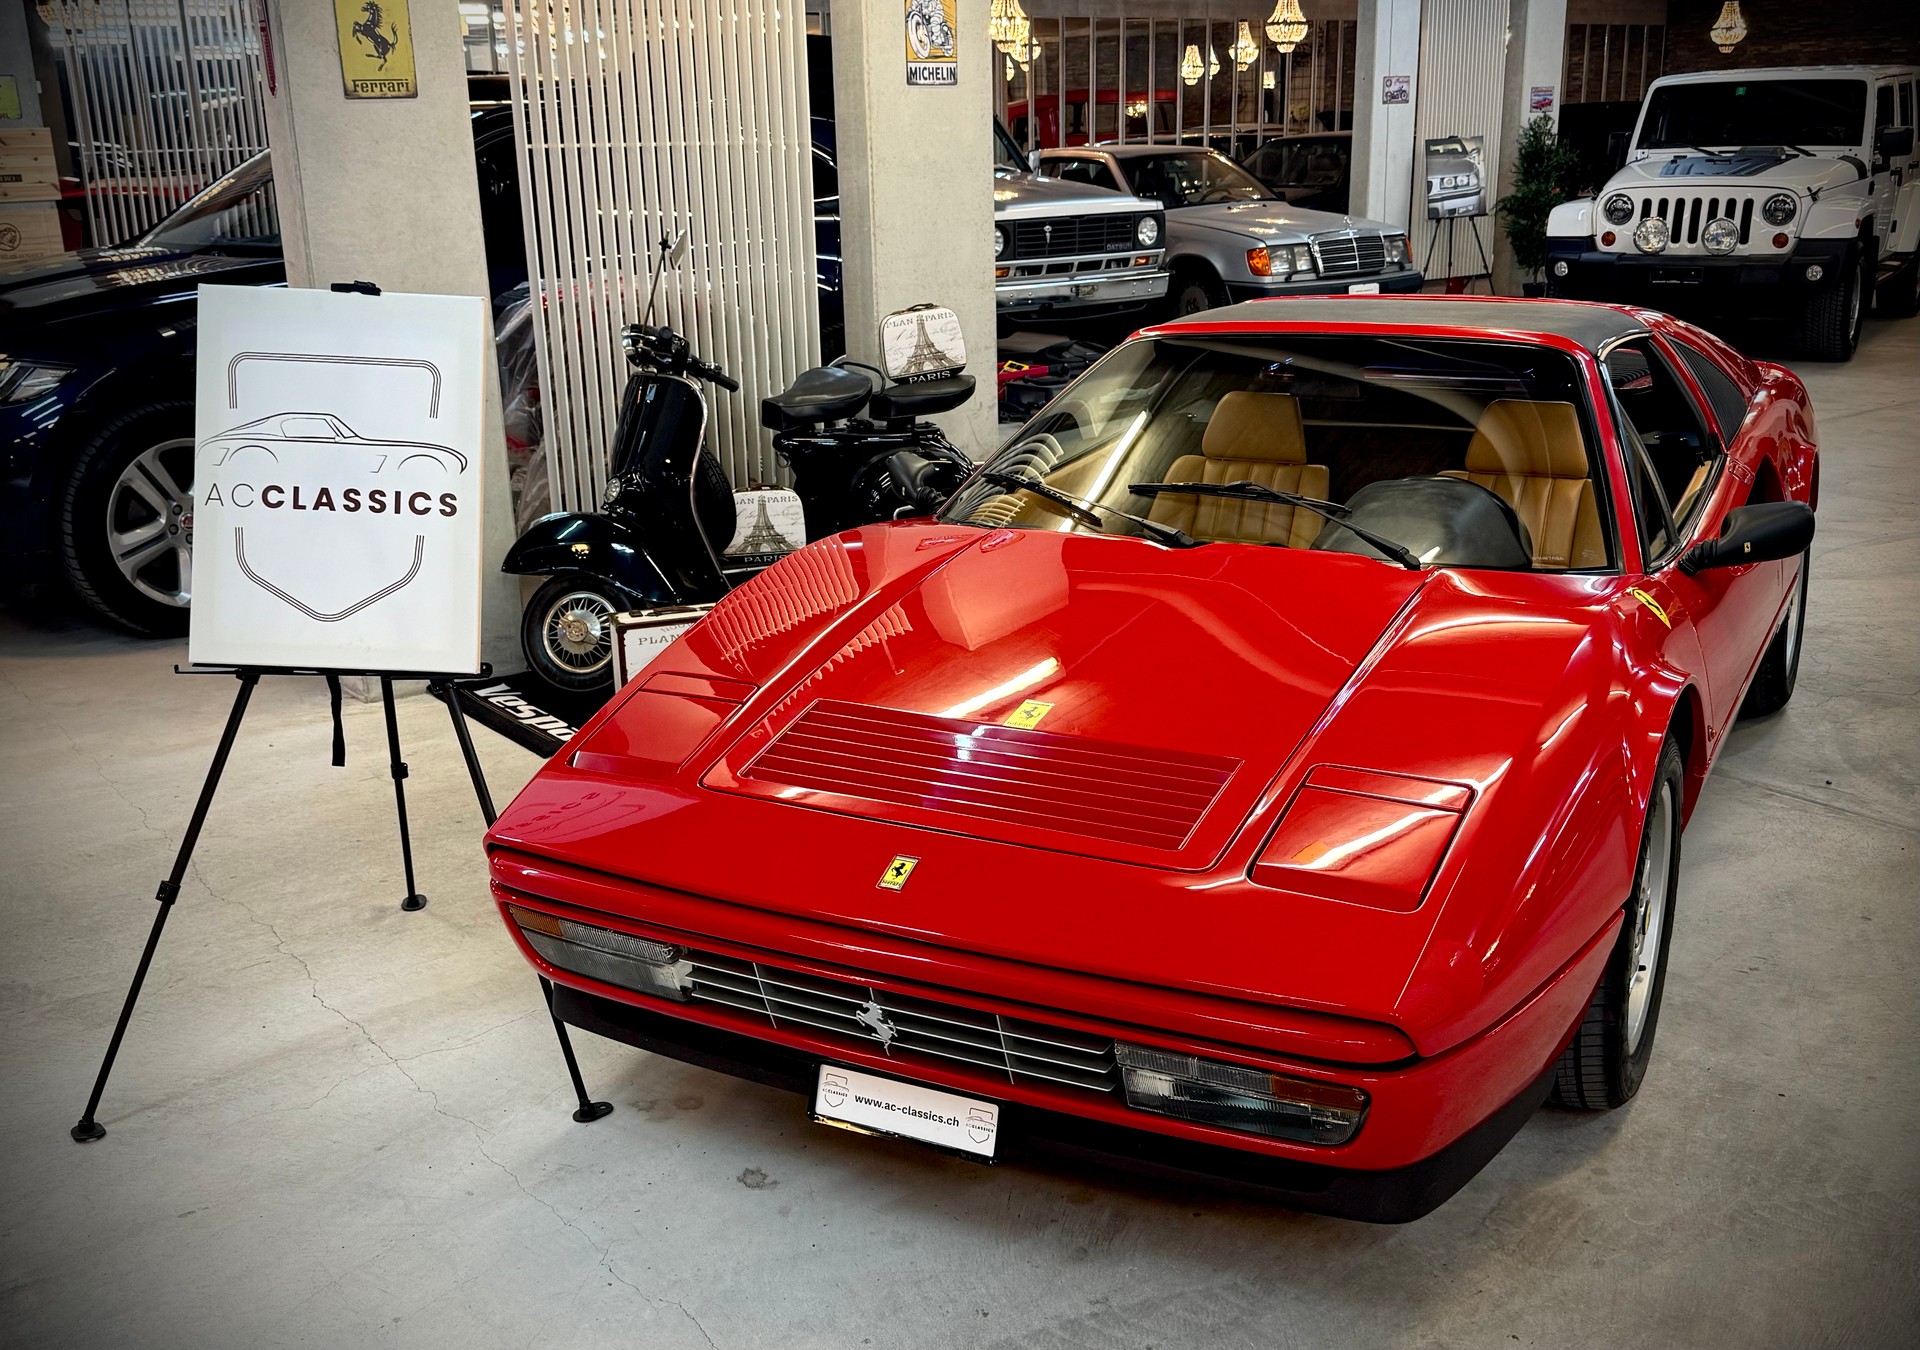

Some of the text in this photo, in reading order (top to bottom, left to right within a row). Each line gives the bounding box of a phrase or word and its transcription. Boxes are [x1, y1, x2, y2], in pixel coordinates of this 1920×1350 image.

[909, 66, 956, 81] MICHELIN
[351, 78, 409, 93] Ferrari
[886, 312, 954, 328] PLAN PARIS
[909, 370, 951, 384] PARIS
[767, 495, 798, 503] PARIS
[473, 683, 580, 742] Vespa
[854, 1094, 960, 1127] www.ac-classics.ch
